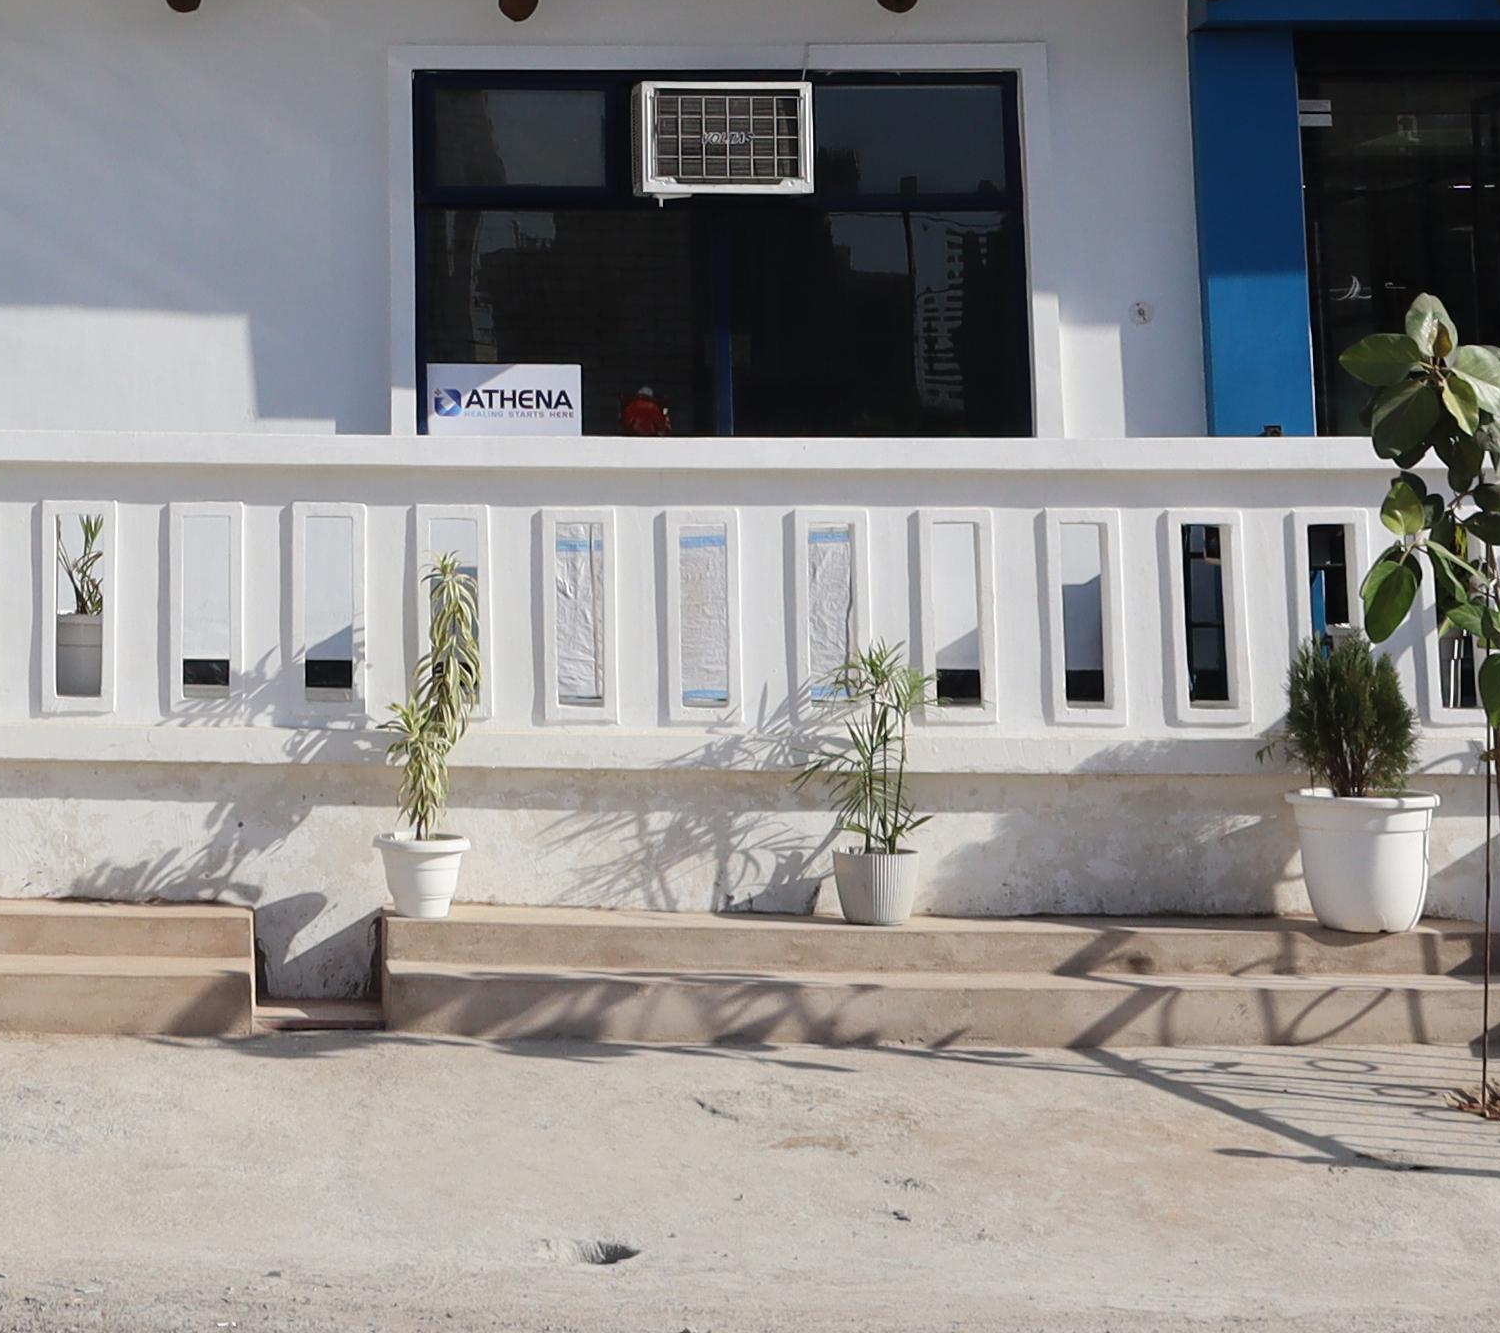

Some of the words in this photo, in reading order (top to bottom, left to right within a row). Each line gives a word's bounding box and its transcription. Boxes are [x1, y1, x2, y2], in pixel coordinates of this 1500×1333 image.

[465, 388, 574, 409] ATHENA
[508, 410, 545, 418] STARTS
[549, 410, 575, 418] HERE
